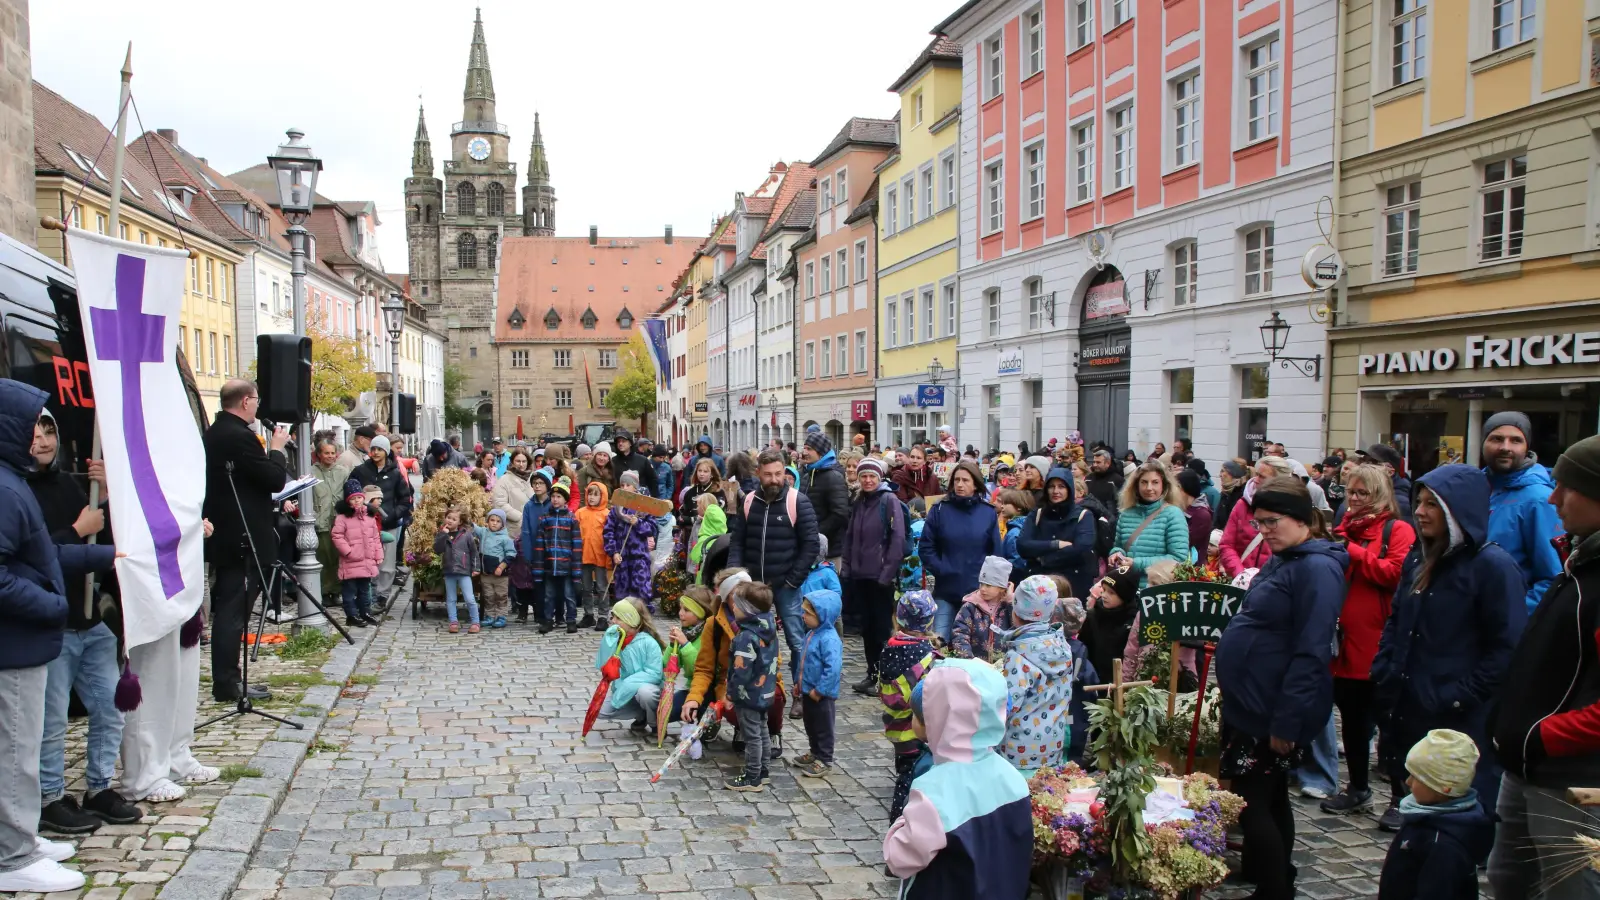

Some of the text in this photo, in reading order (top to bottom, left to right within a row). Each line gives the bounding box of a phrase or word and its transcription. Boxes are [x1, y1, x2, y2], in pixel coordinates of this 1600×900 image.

[1358, 331, 1600, 375] PIANO FRICKE
[921, 397, 941, 406] Apollo
[1181, 625, 1222, 639] KITA
